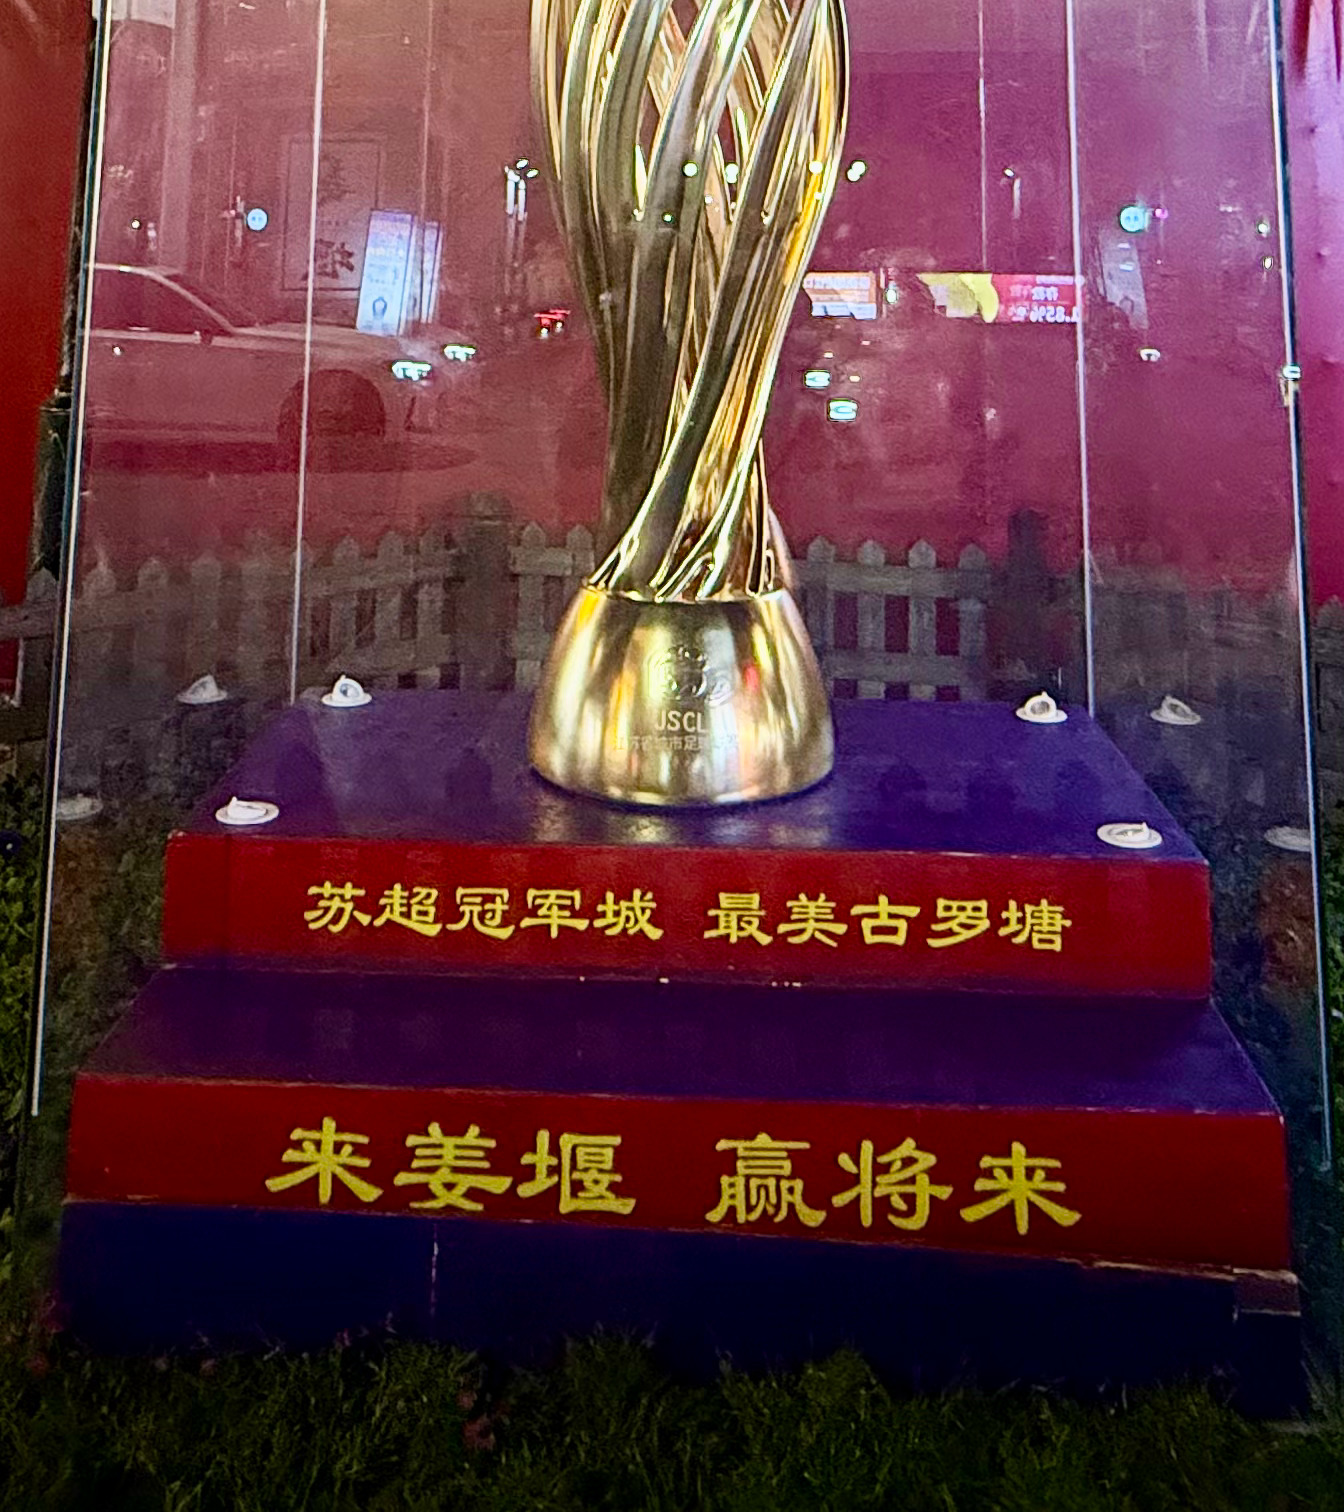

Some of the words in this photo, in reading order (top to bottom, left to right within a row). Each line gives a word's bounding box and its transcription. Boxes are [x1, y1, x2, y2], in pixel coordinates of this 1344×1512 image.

[655, 709, 708, 734] JSCL
[304, 880, 664, 938] 苏超冠军城
[703, 890, 1074, 953] 最美古罗塘
[265, 1115, 637, 1218] 来姜堰
[705, 1131, 1083, 1236] 赢将来
